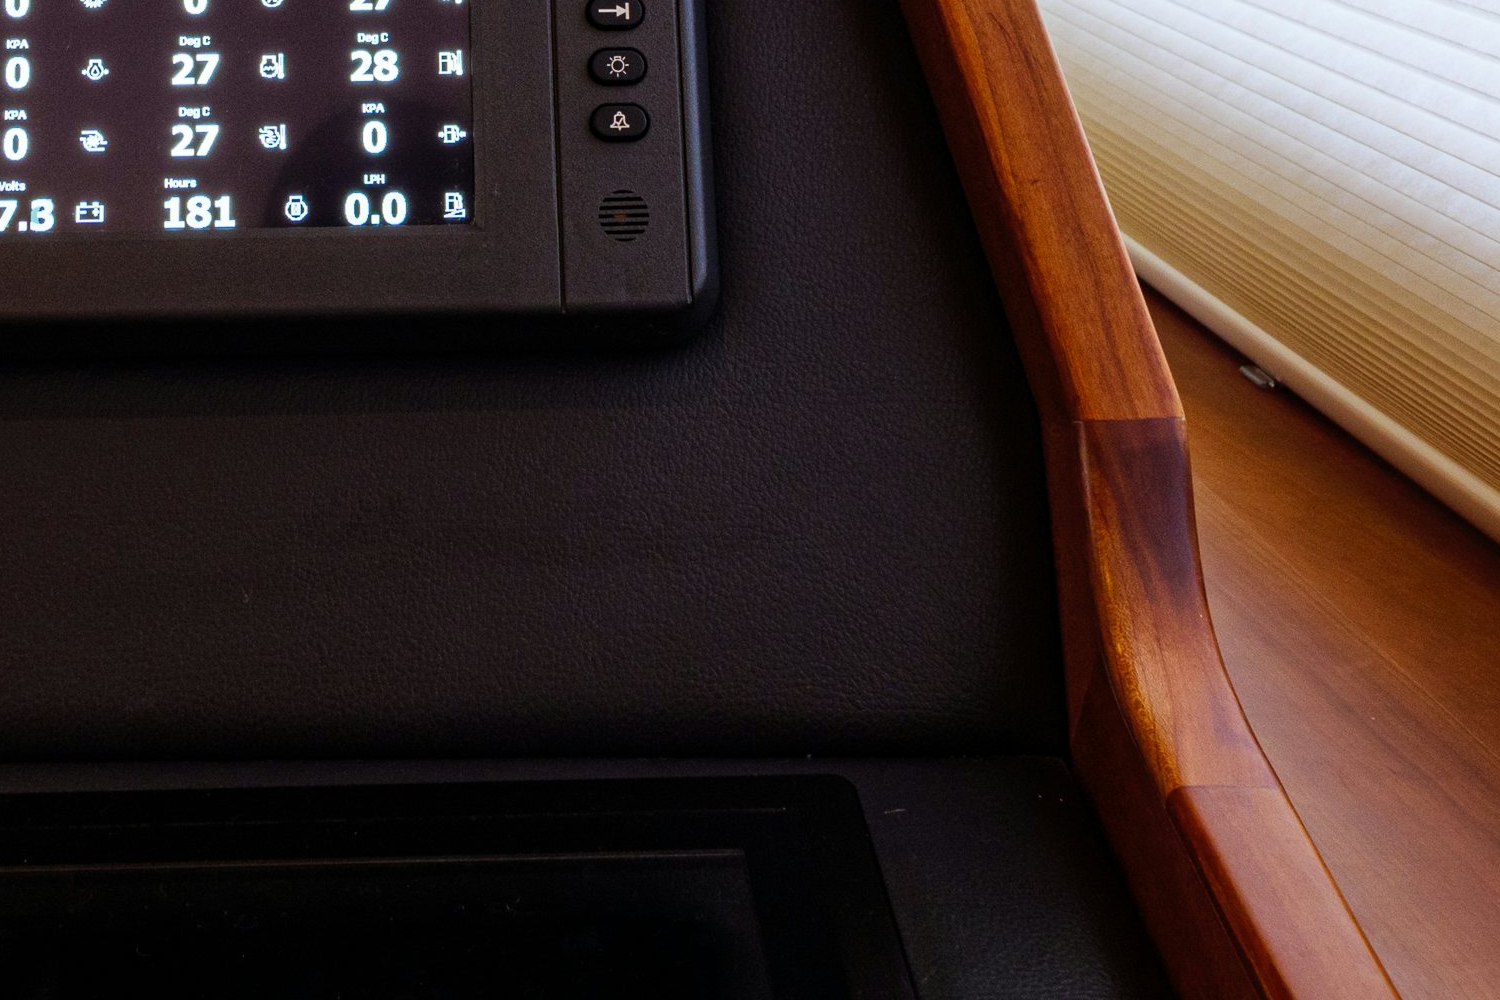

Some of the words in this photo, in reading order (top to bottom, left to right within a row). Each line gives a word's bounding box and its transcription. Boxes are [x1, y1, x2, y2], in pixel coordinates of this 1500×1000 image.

[5, 38, 30, 50] KPA
[179, 35, 200, 48] Deg
[202, 35, 211, 47] C
[357, 32, 378, 46] Deg
[380, 31, 389, 43] C
[4, 55, 30, 90] 0
[171, 52, 220, 87] 27
[350, 49, 400, 84] 28
[3, 109, 28, 121] KPA
[178, 105, 200, 119] Deg
[202, 105, 211, 118] C
[361, 102, 386, 115] KPA
[3, 126, 29, 161] 0
[171, 123, 219, 158] 27
[362, 120, 388, 154] 0
[164, 177, 198, 190] Hours
[363, 173, 386, 185] LPH
[164, 194, 236, 229] 181
[345, 191, 407, 227] 0.0
